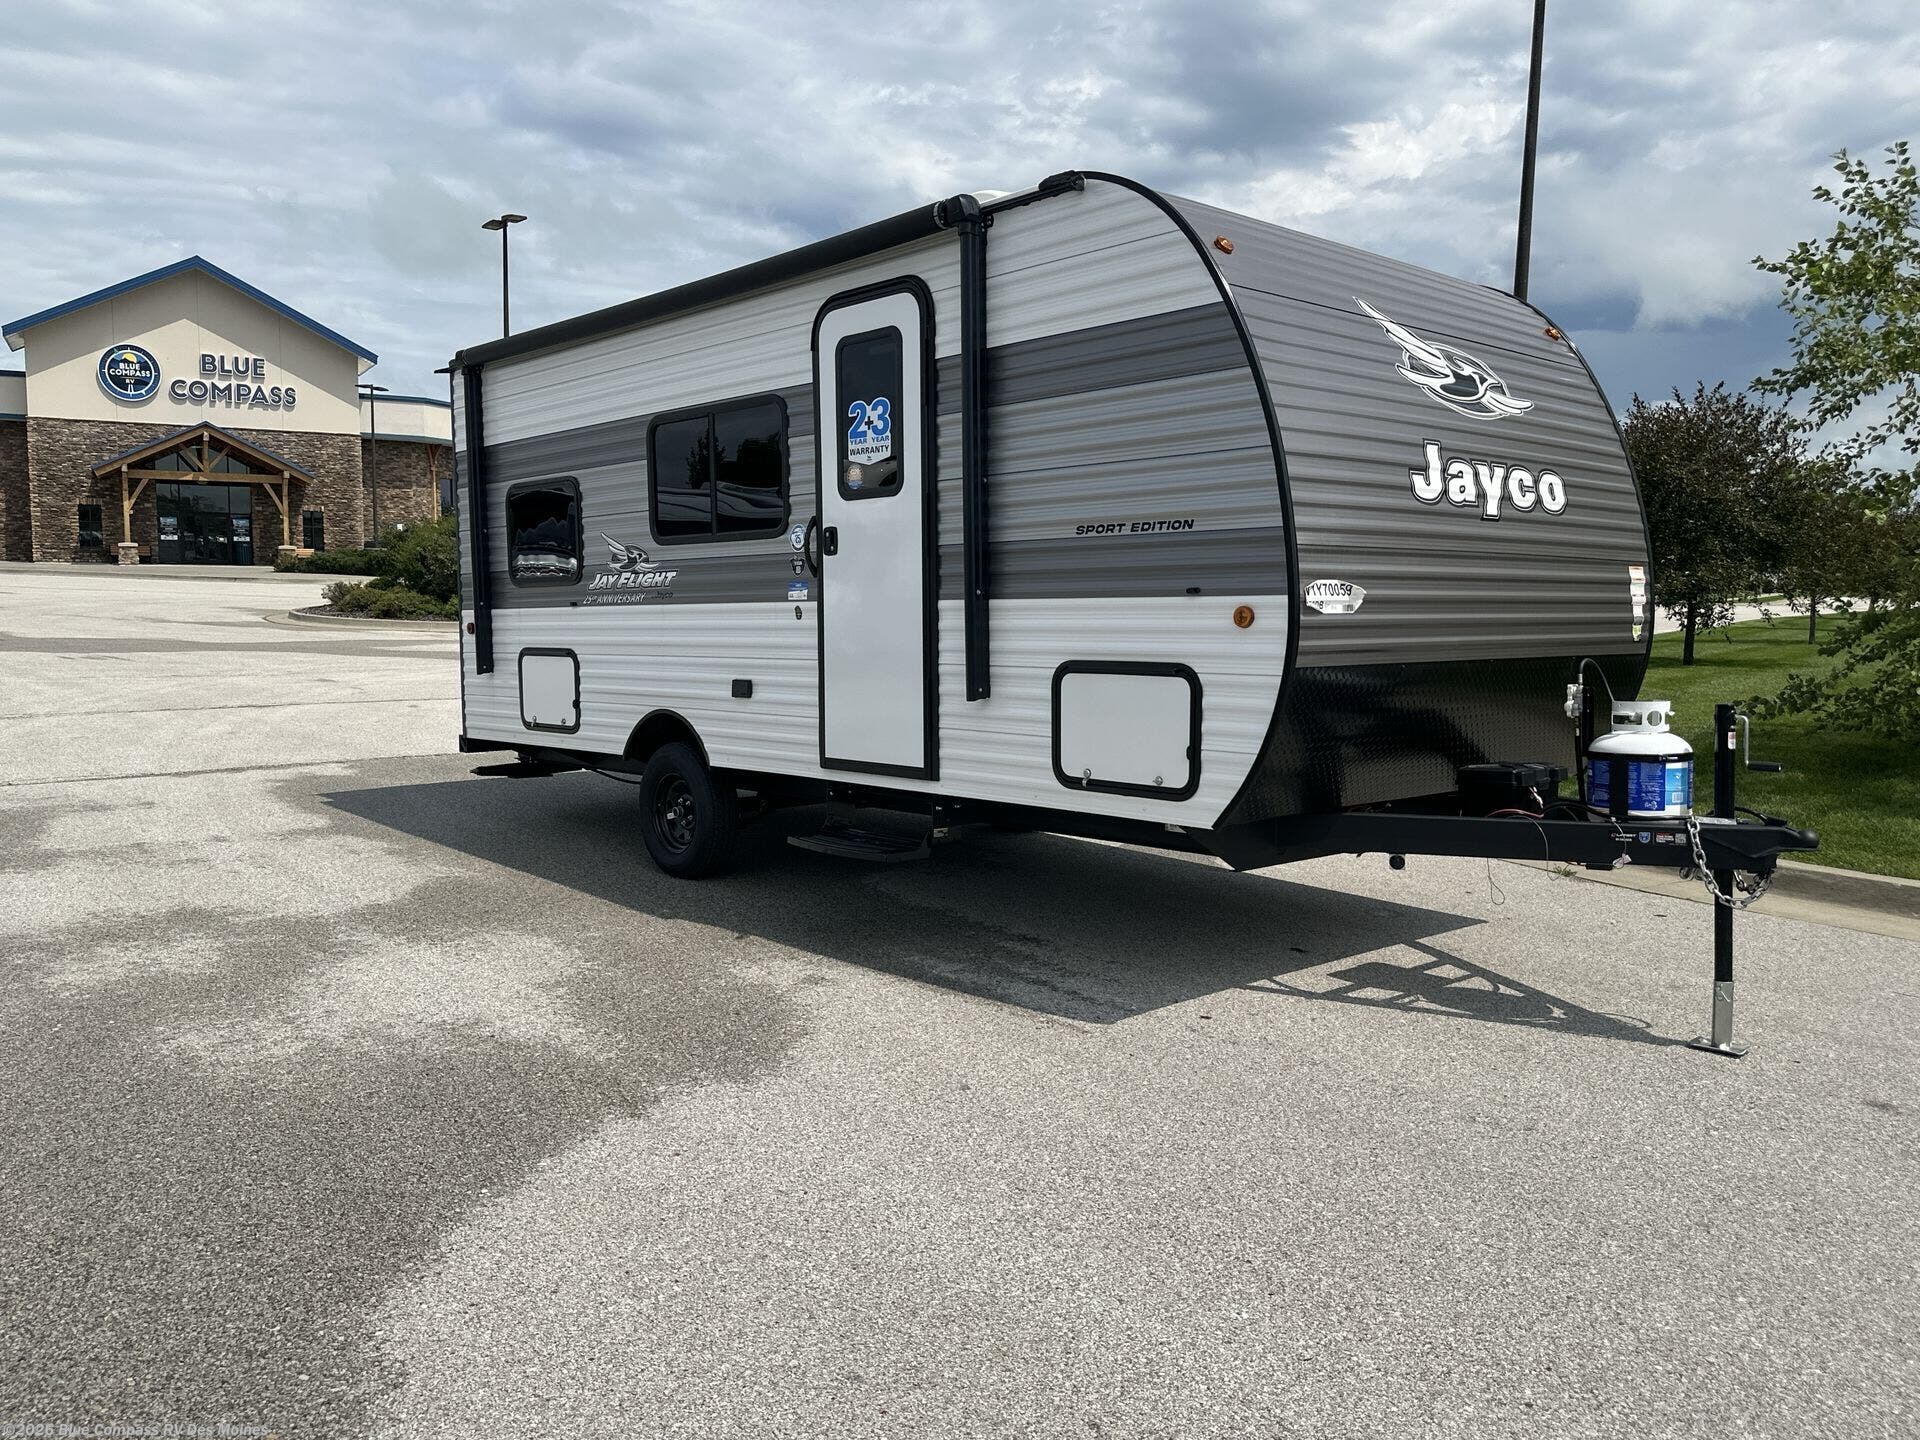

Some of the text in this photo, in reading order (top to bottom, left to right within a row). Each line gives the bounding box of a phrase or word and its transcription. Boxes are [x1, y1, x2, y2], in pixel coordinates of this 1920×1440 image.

[119, 362, 141, 371] BLUE
[200, 353, 265, 377] BLUE
[109, 368, 151, 377] COMPASS
[170, 379, 297, 406] COMPASS
[850, 434, 890, 446] YEAR YEAR
[849, 444, 890, 456] WARRANTY
[1409, 438, 1568, 521] Jayco
[1075, 519, 1195, 535] SPORT EDITION
[588, 570, 678, 591] JAY FLIGHT
[596, 591, 647, 604] ANNIVERSARY
